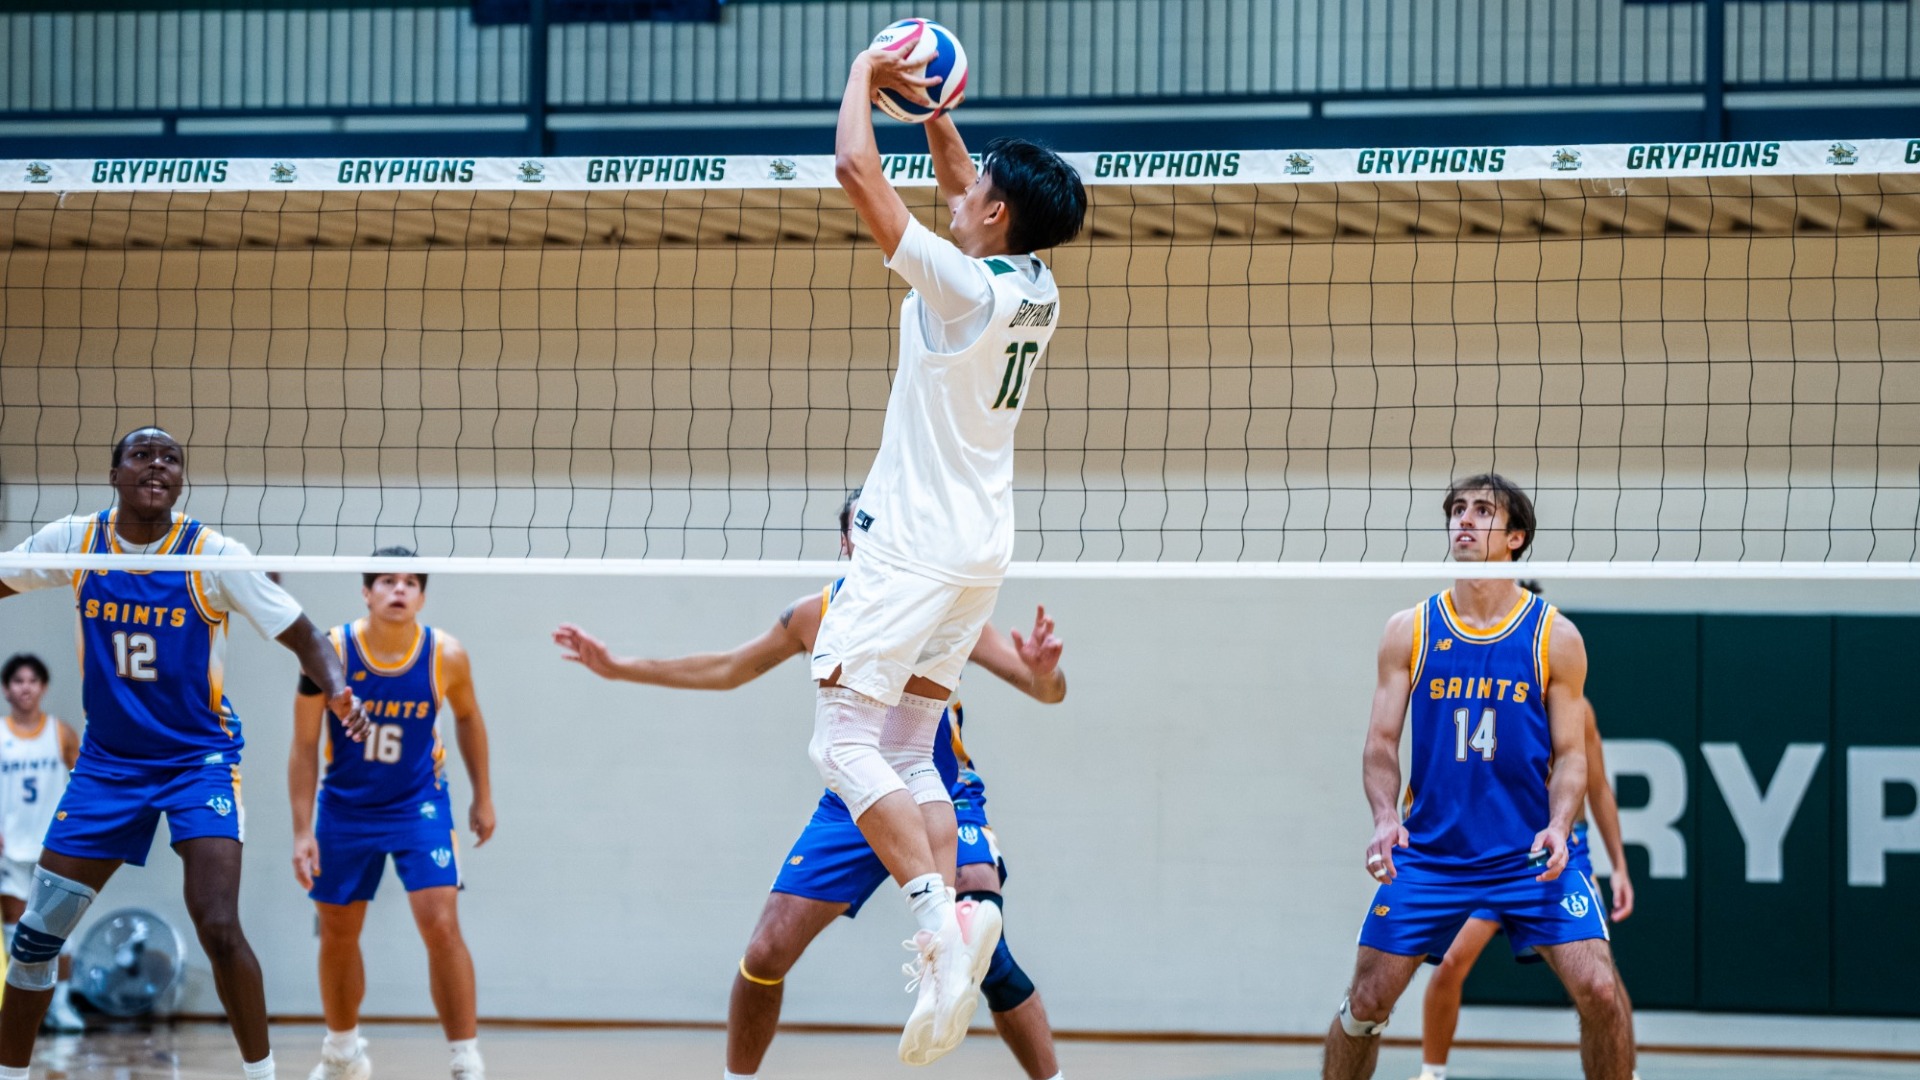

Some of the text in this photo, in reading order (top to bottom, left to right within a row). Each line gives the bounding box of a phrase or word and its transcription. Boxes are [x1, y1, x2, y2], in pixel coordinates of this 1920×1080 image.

[1095, 152, 1241, 178] GRYPHONS
[1356, 148, 1506, 174] GRYPHONS
[1626, 142, 1780, 170] GRYPHONS
[92, 160, 229, 184] GRYPHONS
[337, 159, 475, 184] GRYPHONS
[586, 157, 727, 183] GRYPHONS
[84, 598, 187, 628] SAINTS
[111, 630, 158, 682] 12
[1429, 676, 1530, 703] SAINTS
[364, 699, 430, 719] AINTS
[363, 722, 404, 765] 16
[1454, 707, 1498, 762] 14
[22, 777, 38, 805] 5
